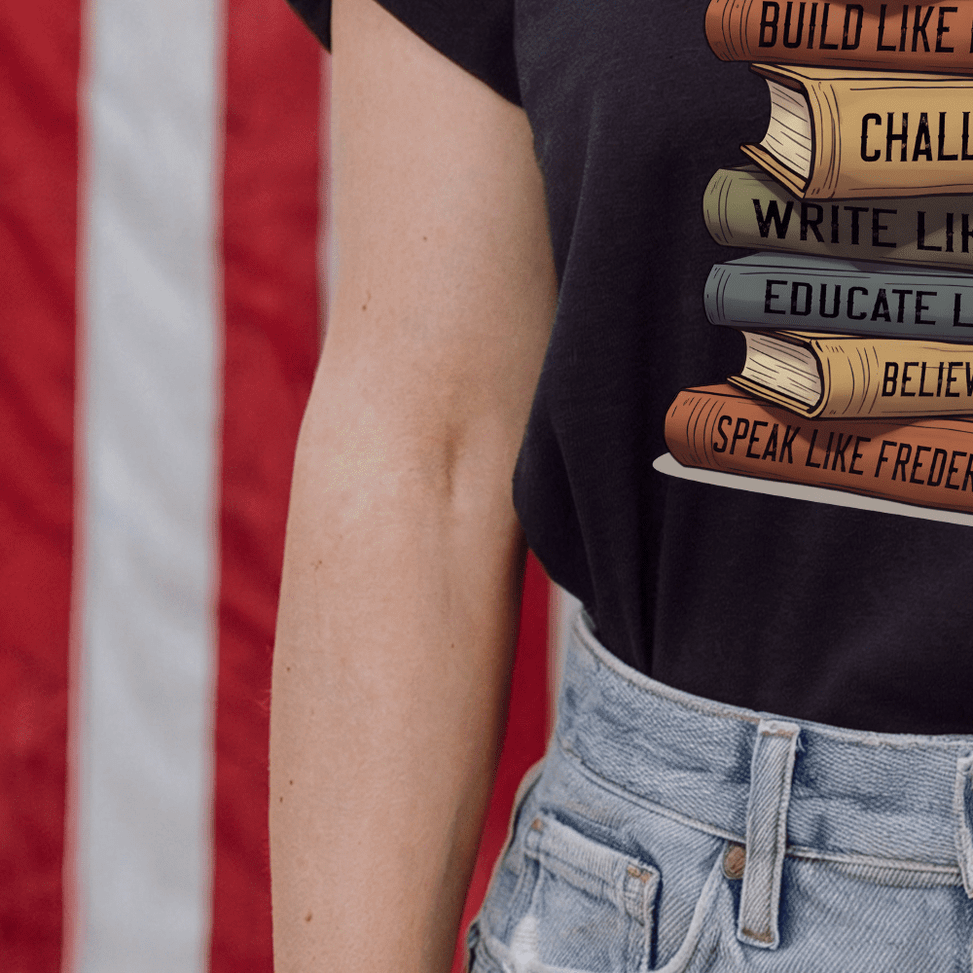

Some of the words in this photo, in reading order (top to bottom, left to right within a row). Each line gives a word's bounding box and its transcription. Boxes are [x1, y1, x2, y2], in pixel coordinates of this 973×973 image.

[758, 0, 864, 50] BUILD
[877, 5, 958, 53] LIKE
[752, 198, 898, 248] WRITE
[764, 280, 937, 326] EDUCATE
[712, 415, 799, 465] SPEAK
[805, 428, 871, 476] LIKE
